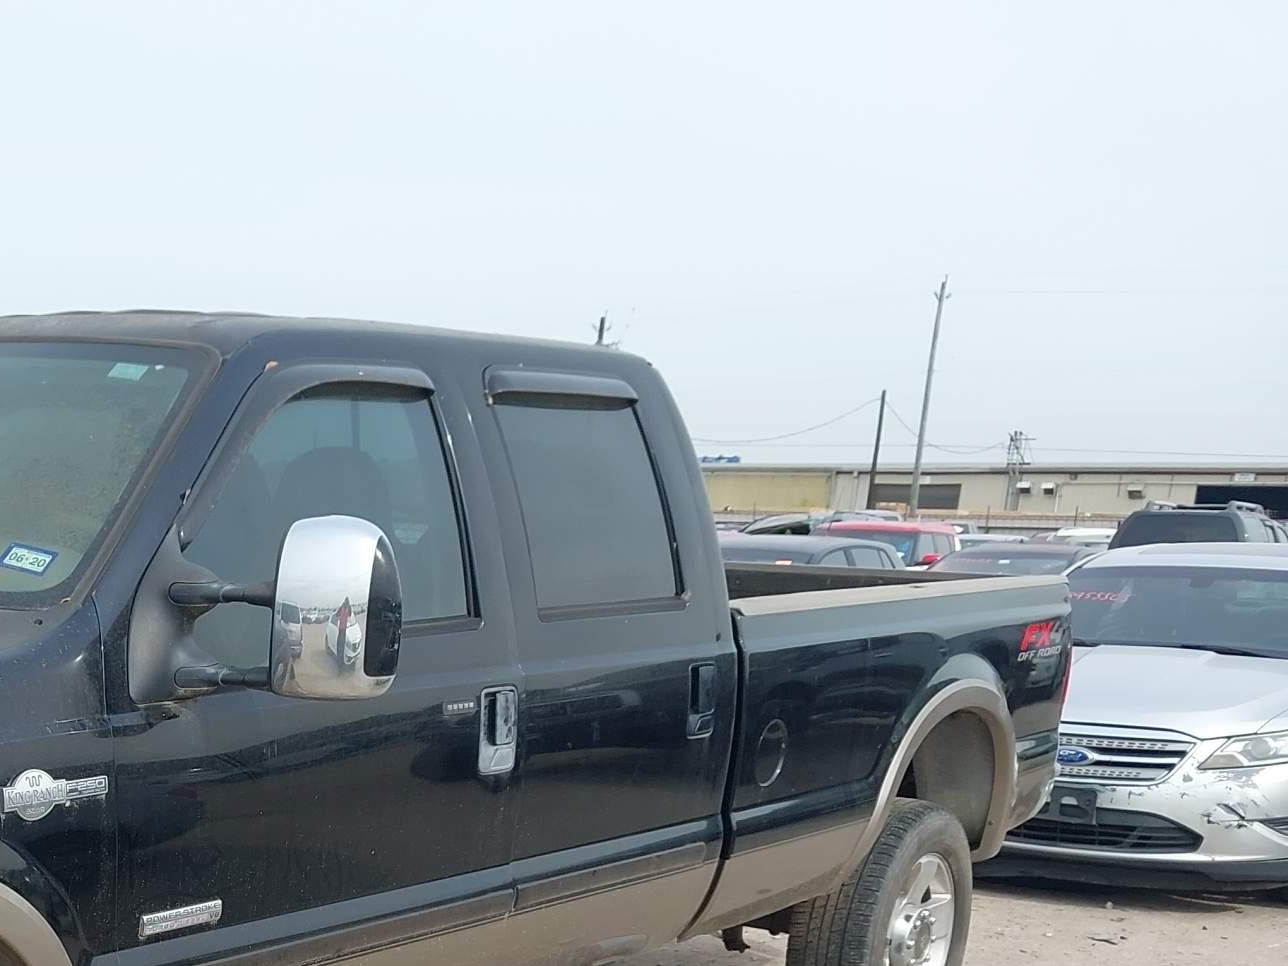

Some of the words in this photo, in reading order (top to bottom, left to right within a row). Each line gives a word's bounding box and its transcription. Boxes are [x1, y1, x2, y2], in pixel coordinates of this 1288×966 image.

[1019, 619, 1064, 651] FX4
[1017, 650, 1036, 662] OFF
[1037, 645, 1063, 658] ROAD
[7, 789, 31, 806] KING
[32, 783, 65, 803] RANCH
